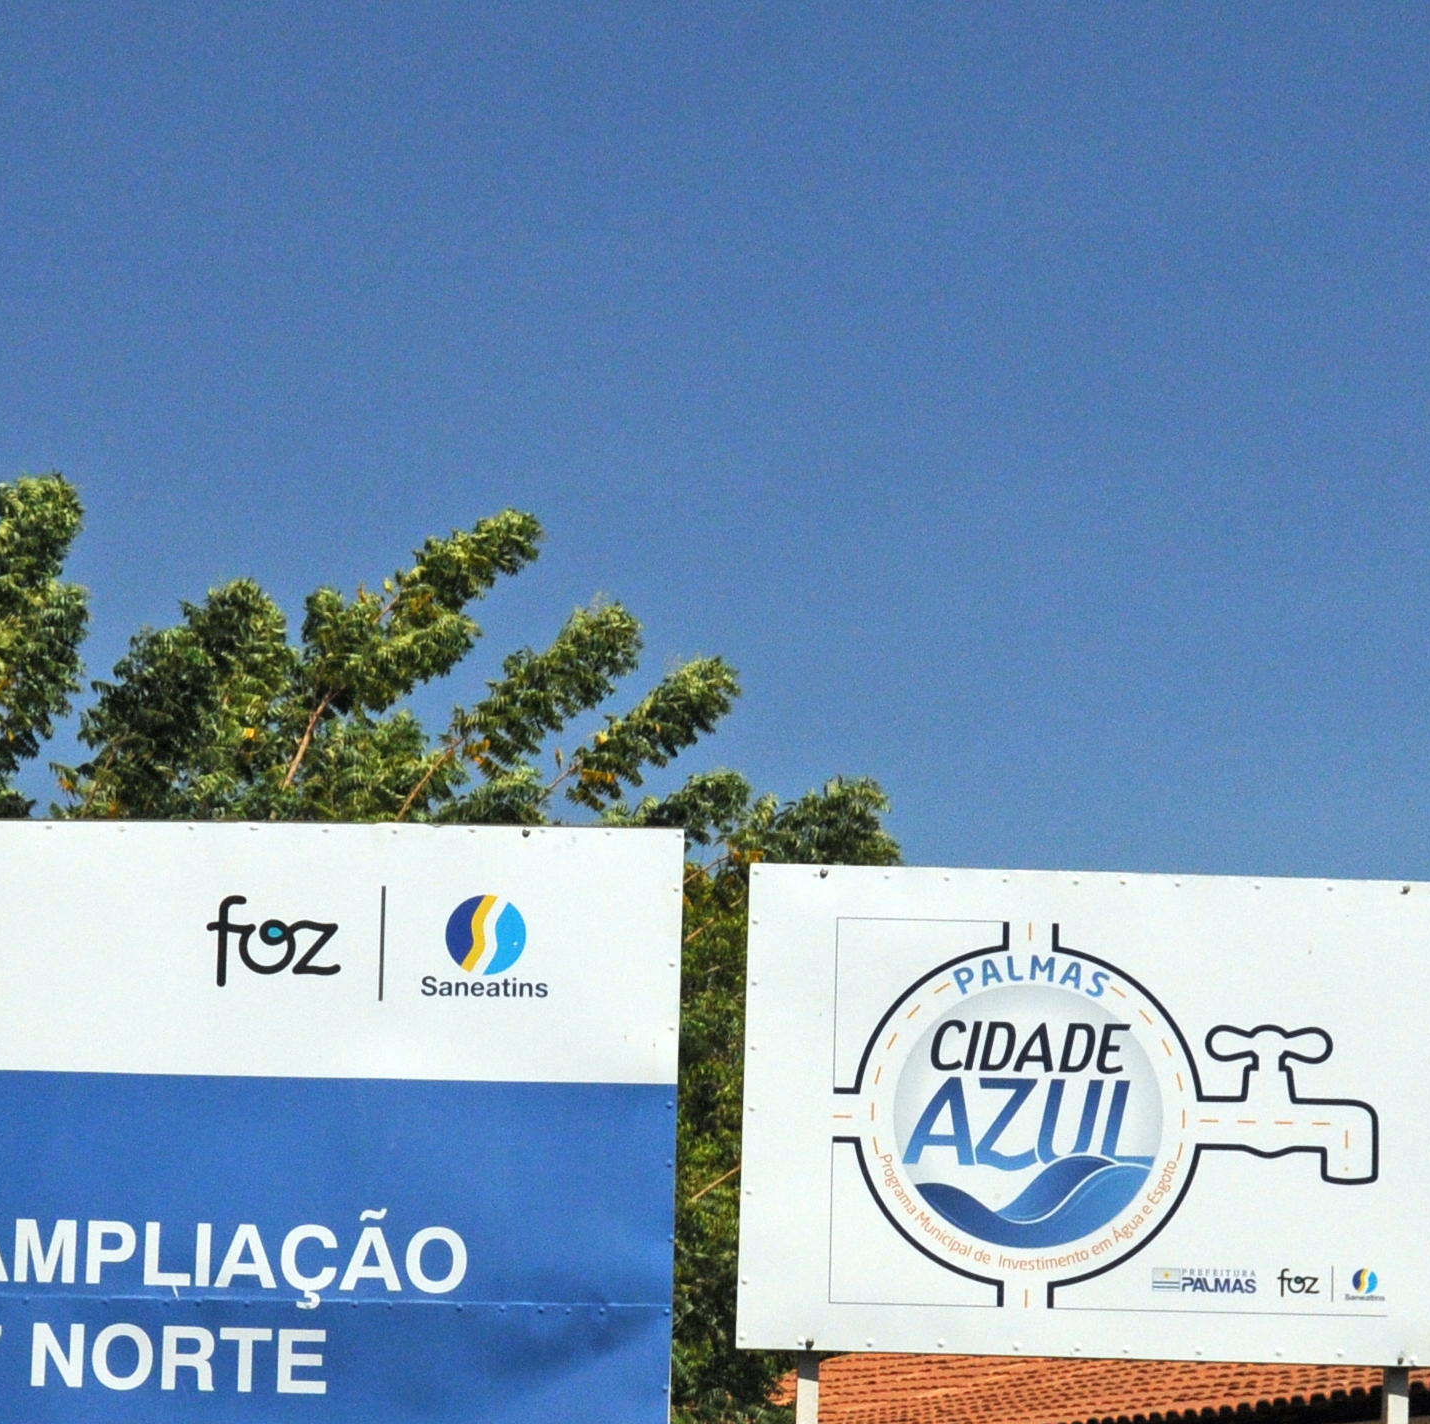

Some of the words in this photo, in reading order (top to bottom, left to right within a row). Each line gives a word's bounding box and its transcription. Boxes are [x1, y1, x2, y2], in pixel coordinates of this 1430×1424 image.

[207, 895, 341, 987] foz
[420, 975, 549, 999] Saneatins
[952, 954, 1111, 998] PALMAS
[930, 1019, 1132, 1075] CIDADE
[902, 1076, 1155, 1171] AZUL
[879, 1153, 917, 1215] Programa
[1146, 1160, 1178, 1205] Esgoto
[1142, 1204, 1153, 1215] e
[914, 1210, 973, 1257] Municipal
[1112, 1213, 1144, 1243] Água
[973, 1249, 992, 1265] de
[998, 1249, 1090, 1271] Investimento
[1091, 1238, 1113, 1255] em
[1181, 1268, 1257, 1278] PREFEITURA
[1181, 1277, 1257, 1294] PALMAS
[1277, 1268, 1320, 1297] foz
[29, 1322, 327, 1395] NORTE
